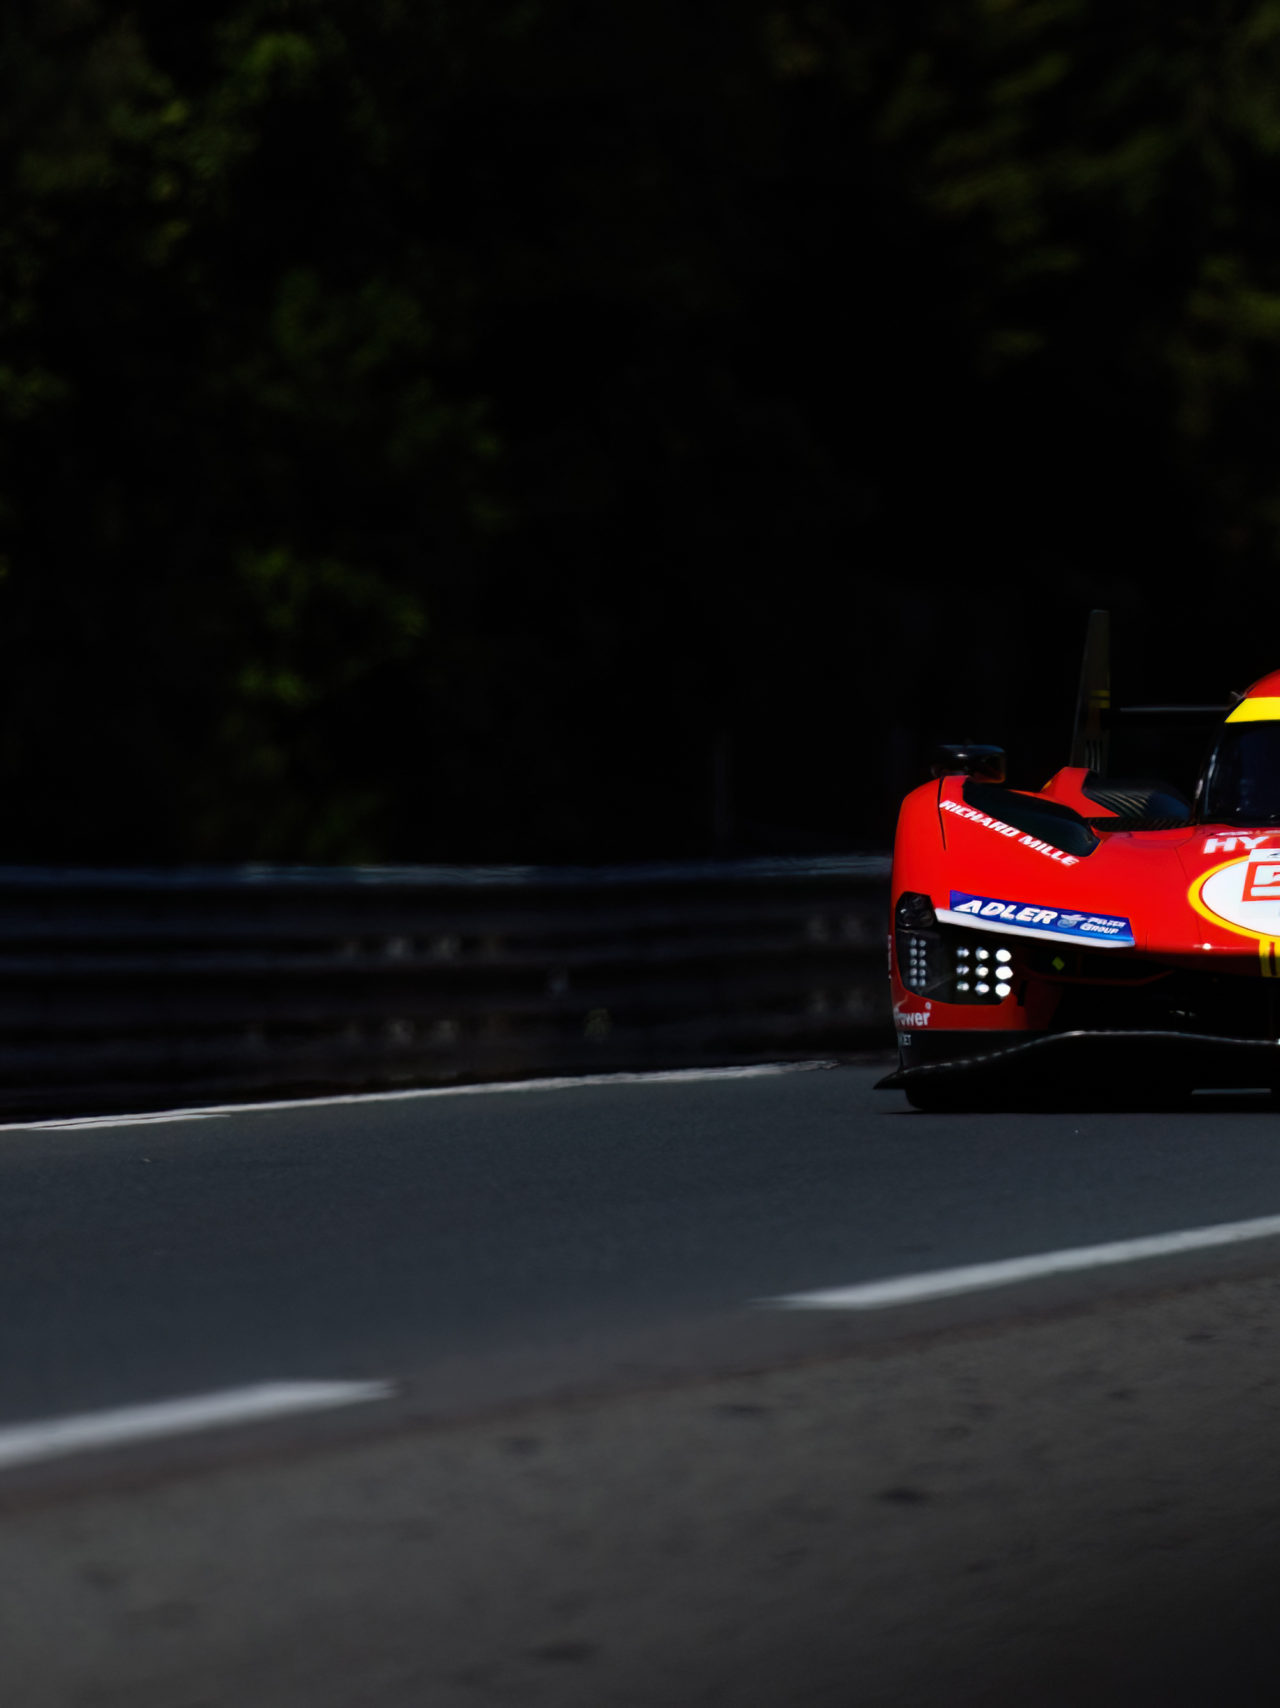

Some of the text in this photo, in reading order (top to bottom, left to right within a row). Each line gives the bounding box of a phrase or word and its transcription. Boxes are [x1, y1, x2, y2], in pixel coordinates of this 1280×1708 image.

[939, 800, 1079, 867] RICHARD MILLE
[953, 900, 1059, 924] ADLER
